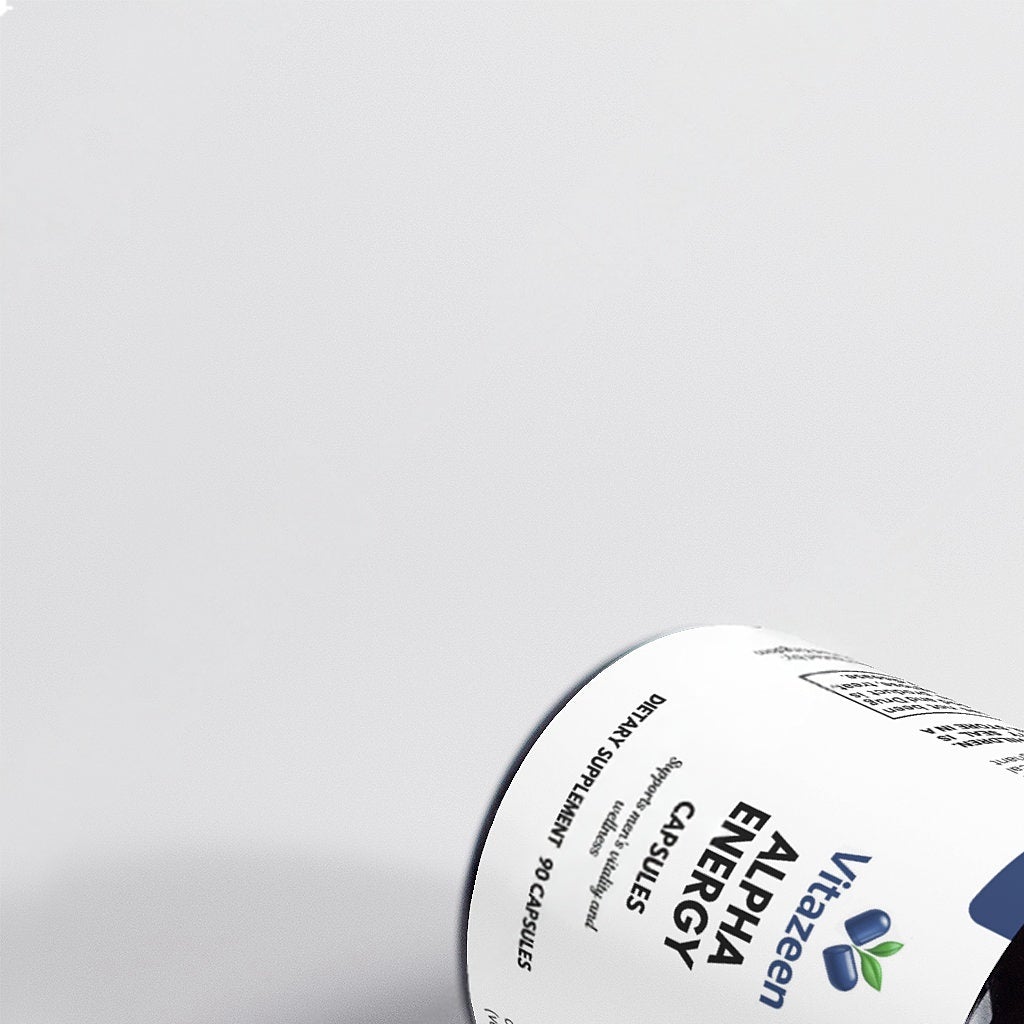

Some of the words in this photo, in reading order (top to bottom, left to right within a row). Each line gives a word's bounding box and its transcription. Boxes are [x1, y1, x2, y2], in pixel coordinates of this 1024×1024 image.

[608, 693, 667, 749] DIETARY
[862, 696, 909, 706] Drug
[882, 704, 929, 714] been
[919, 727, 936, 735] A
[936, 734, 957, 742] IS
[548, 746, 613, 849] SUPPLEMENT
[638, 756, 683, 812] Supports
[588, 800, 625, 857] wellness
[614, 811, 641, 850] men's
[535, 856, 554, 881] 90
[589, 850, 619, 899] vitality
[626, 801, 695, 915] CAPSULES
[663, 801, 772, 971] ENERGY
[585, 899, 600, 932] and
[706, 830, 799, 965] ALPHA
[517, 883, 545, 972] CAPSULES
[758, 852, 872, 1009] Vitazeen
